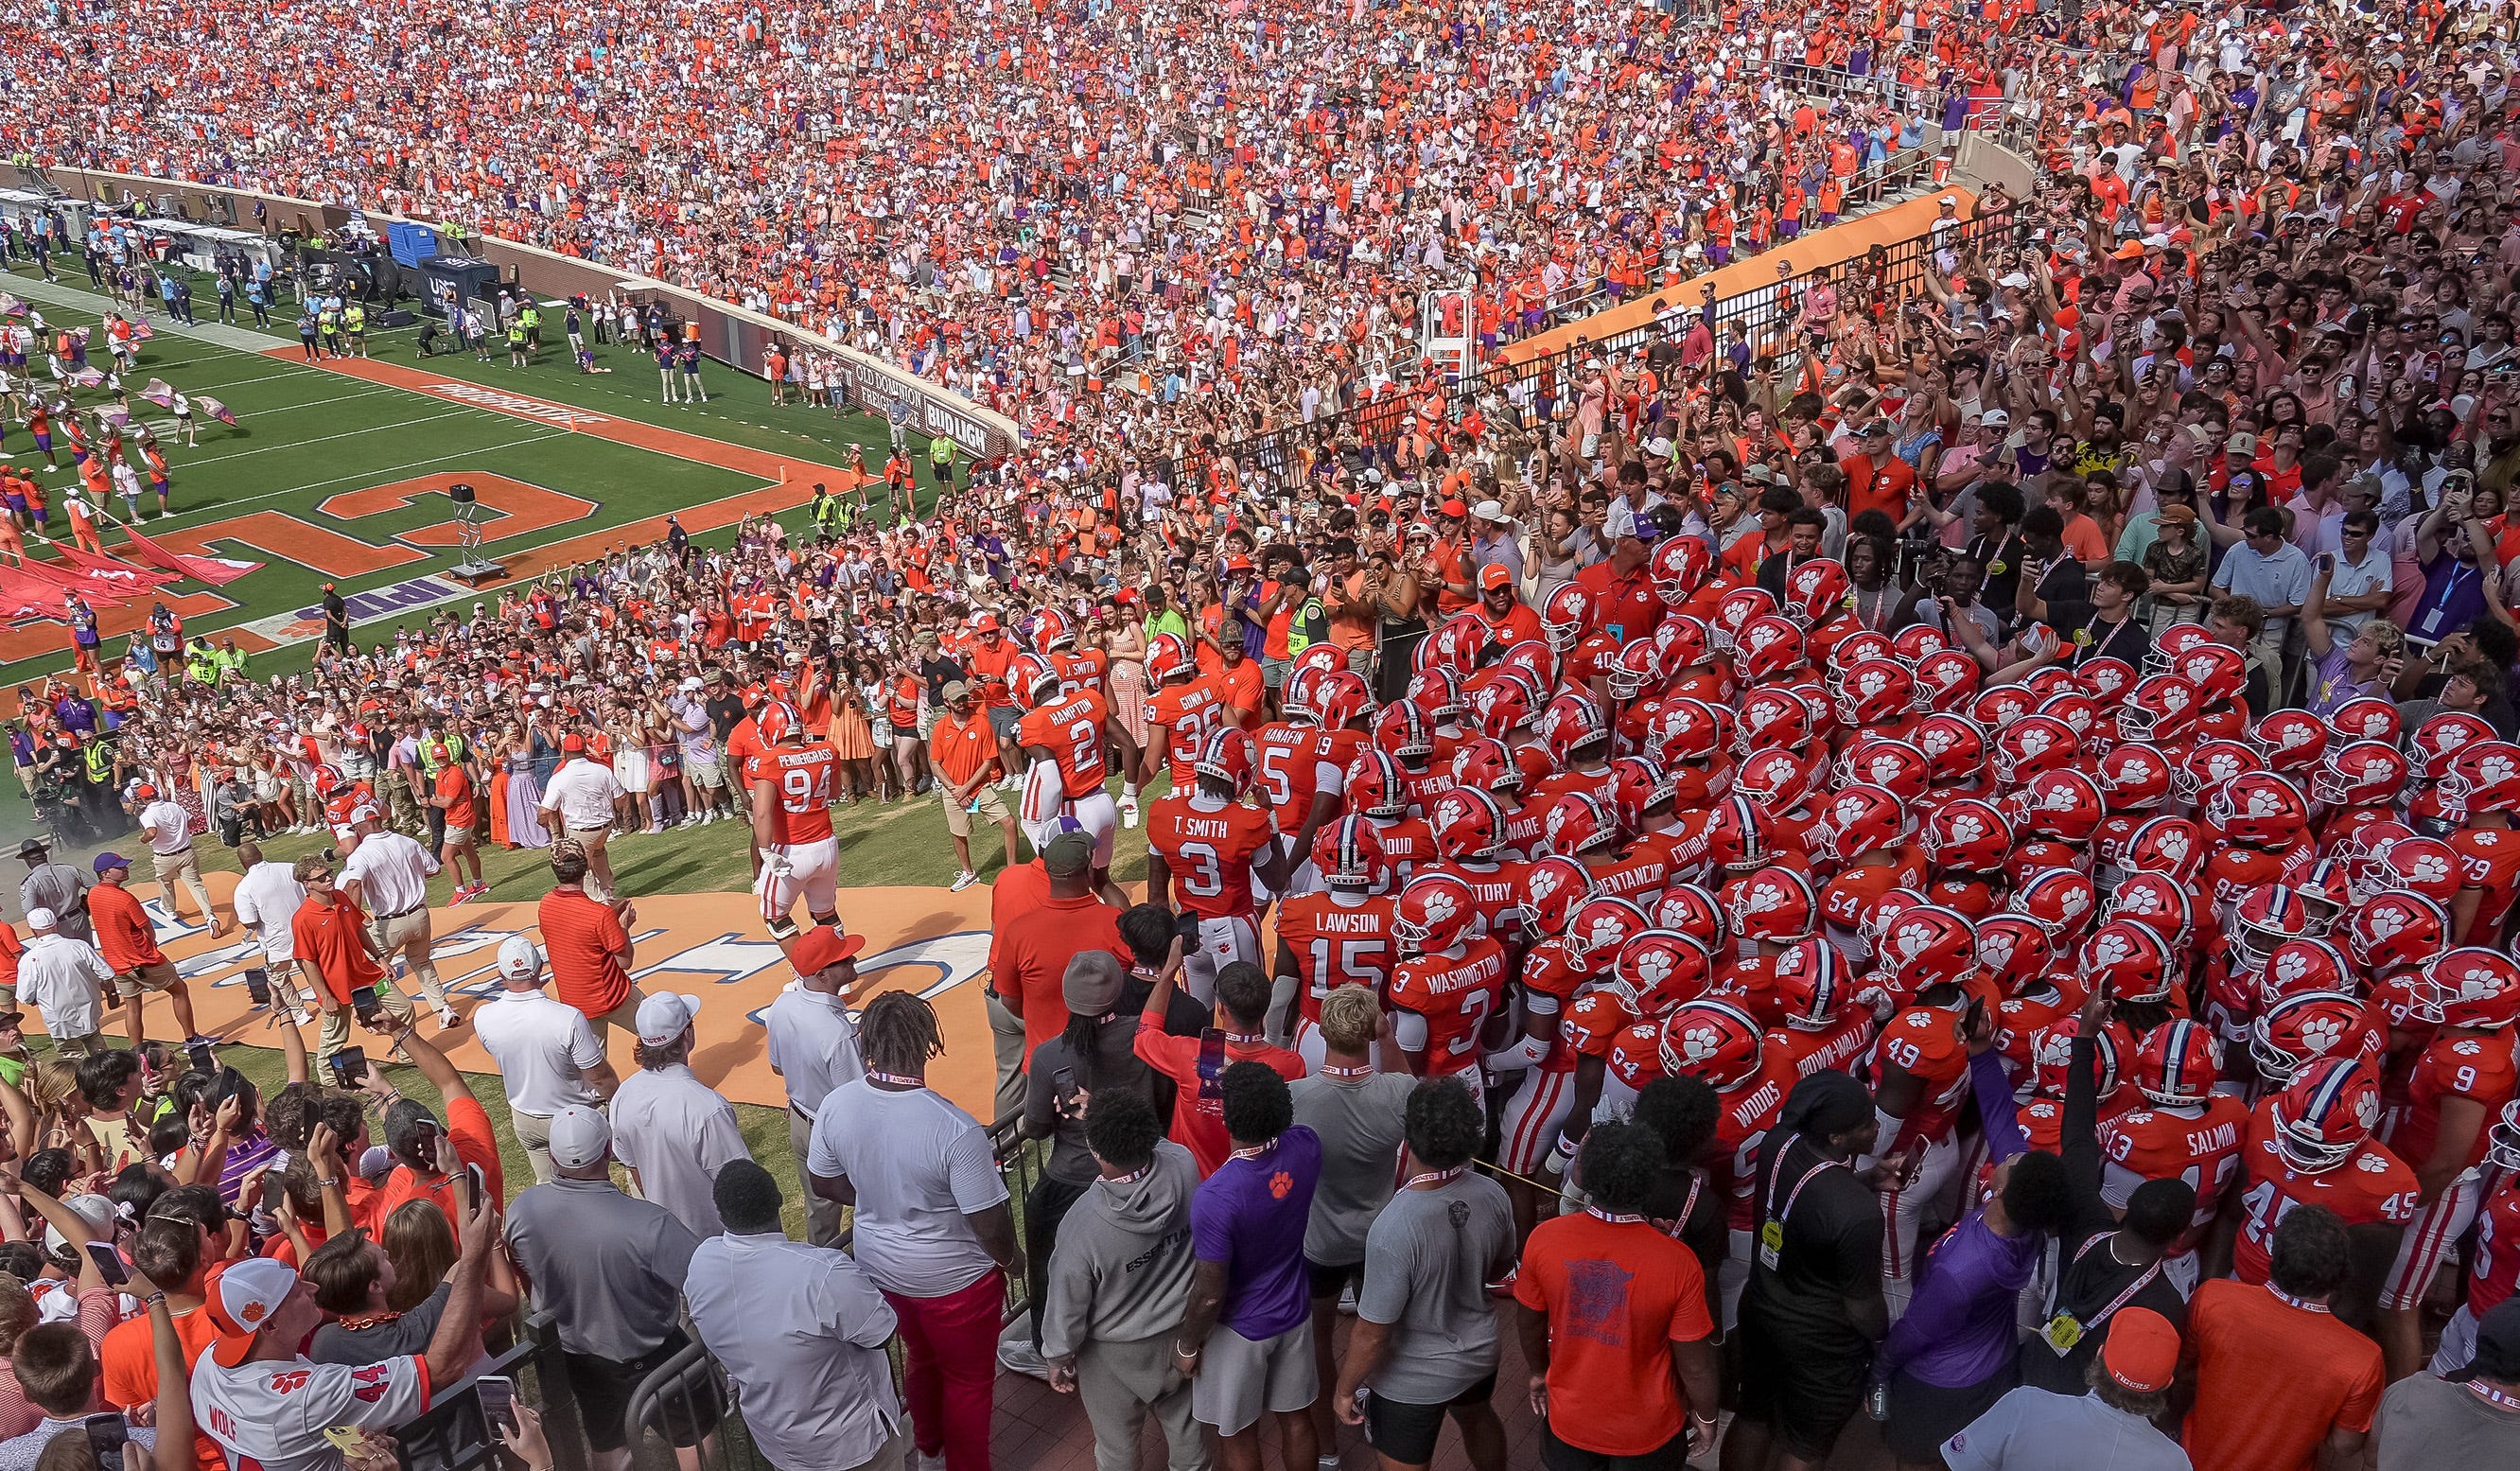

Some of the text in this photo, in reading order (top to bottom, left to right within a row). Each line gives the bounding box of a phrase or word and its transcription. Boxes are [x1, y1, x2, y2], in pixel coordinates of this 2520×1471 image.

[856, 365, 874, 387] OLD
[876, 373, 921, 409] DOMINION
[418, 382, 610, 425] PROGRESSIVE
[927, 406, 988, 454] BUD LIGH
[1074, 661, 1096, 674] SMITH
[1593, 651, 1616, 669] 40
[198, 670, 211, 680] 15
[1048, 697, 1094, 726] HAMPTON
[1179, 693, 1203, 711] GUNN
[1068, 719, 1100, 774] 2
[1263, 727, 1307, 745] HANAFIN
[1315, 735, 1333, 756] 19
[778, 747, 833, 768] PENDERGRASS
[782, 763, 832, 814] 94
[1262, 745, 1293, 805] 5
[1173, 814, 1228, 839] T. SMITH
[1178, 840, 1224, 898] 3
[2282, 845, 2314, 872] ADAMS
[2460, 854, 2492, 882] 79
[1326, 876, 1367, 884] CLEMSON
[1828, 889, 1860, 919] 54
[1316, 912, 1380, 933] LAWSON
[1309, 937, 1386, 999] 15
[1392, 966, 1410, 993] 3
[1425, 953, 1501, 995] WASHINGTON
[1522, 953, 1550, 981] 37
[1446, 987, 1491, 1057] 3
[1886, 1037, 1920, 1069] 49
[2453, 1064, 2477, 1092] 9
[1731, 1079, 1781, 1129] WOODS
[2146, 1091, 2197, 1105] CLEMSON
[2186, 1122, 2237, 1156] SALMIN
[2380, 1191, 2419, 1220] 45
[1126, 1227, 1192, 1274] ESSENTIA
[352, 1363, 390, 1403] 44
[2114, 1369, 2151, 1391] TIGERS
[209, 1403, 236, 1442] WOLF
